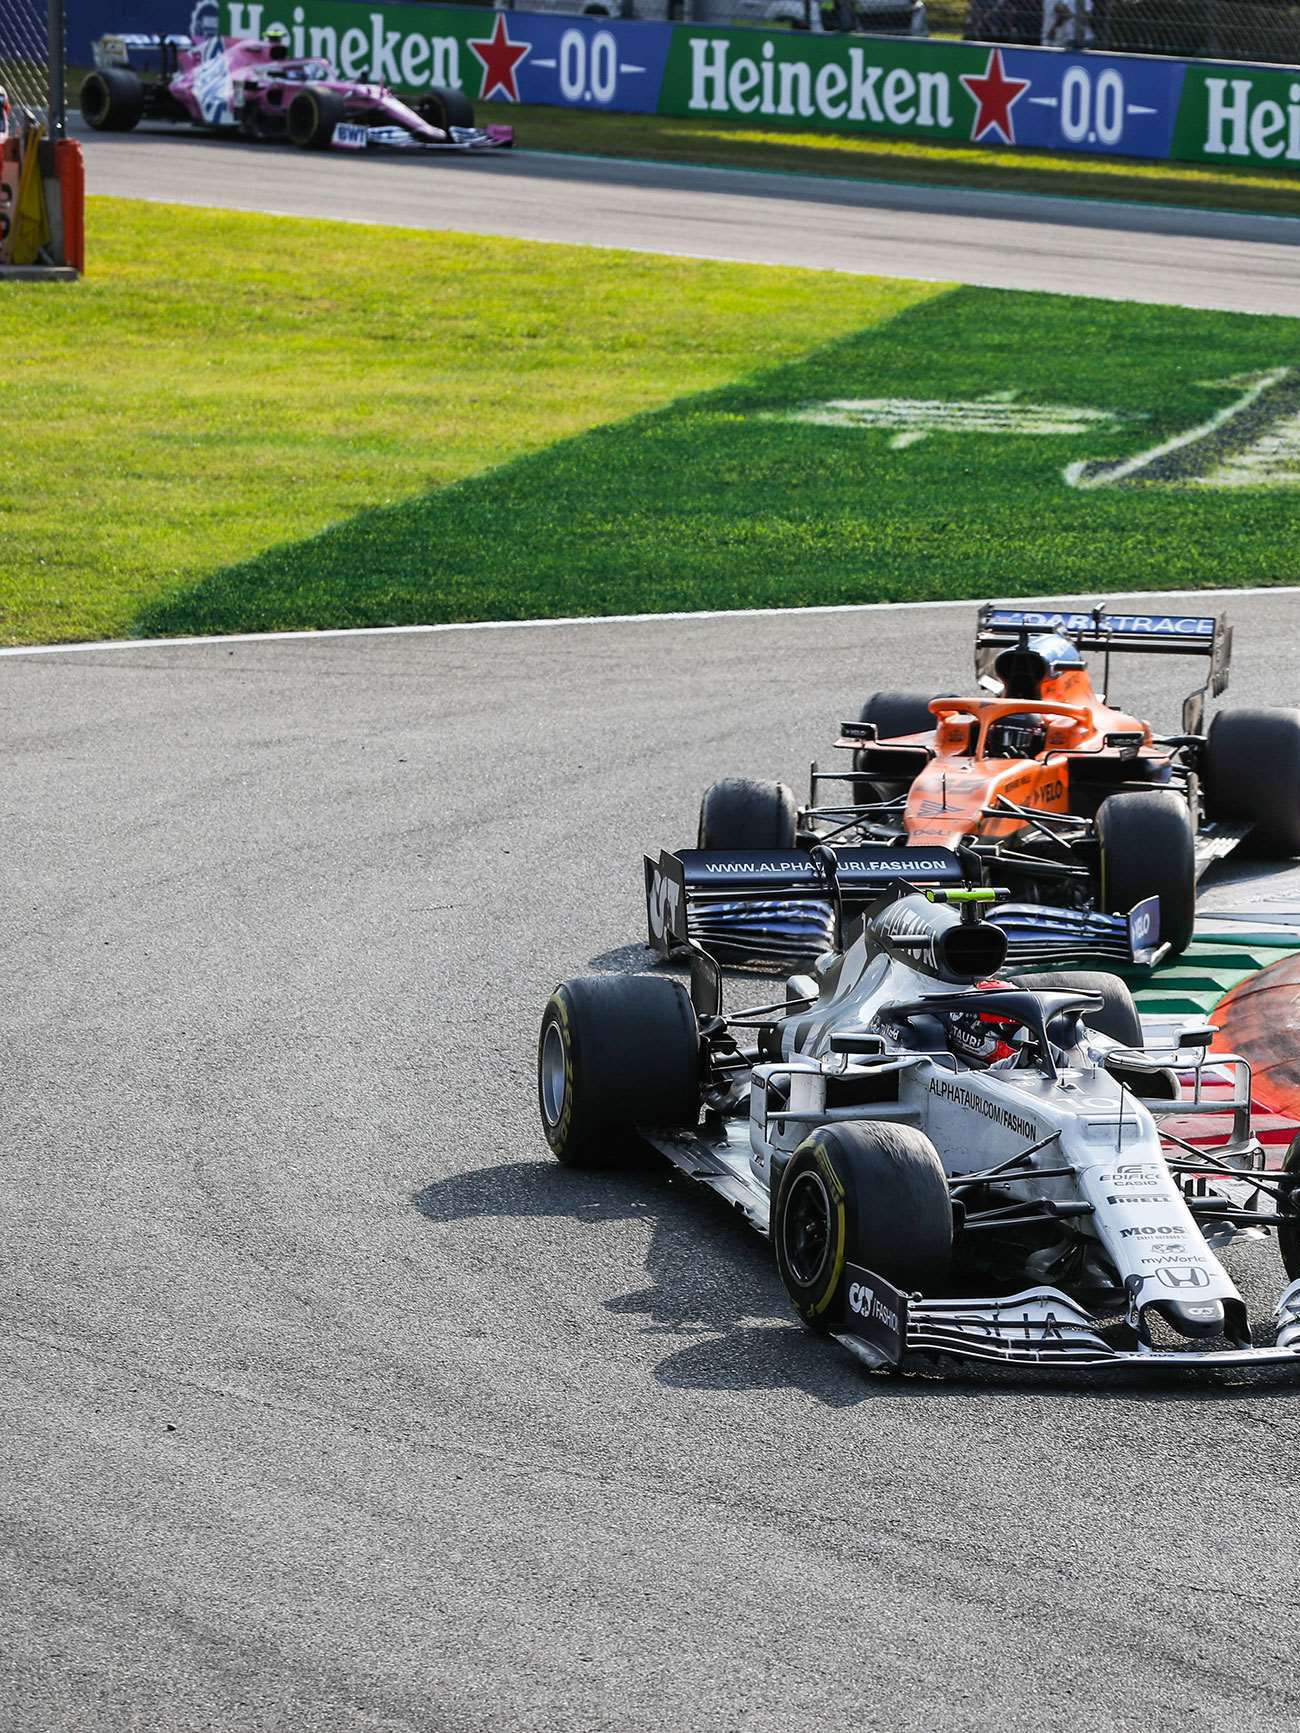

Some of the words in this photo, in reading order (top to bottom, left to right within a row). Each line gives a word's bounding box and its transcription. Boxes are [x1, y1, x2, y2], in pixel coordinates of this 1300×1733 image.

[560, 28, 617, 103] 0.0
[688, 37, 952, 128] Heineken
[1060, 65, 1125, 145] 0.0
[1025, 610, 1216, 636] DARKTRACE
[1039, 779, 1064, 804] VELO
[705, 860, 947, 874] WWW.ALPHAURI.FASHION
[929, 1077, 1037, 1142] ALPHATAURI.COM/FASHION
[1106, 1194, 1172, 1205] PIRELL
[1119, 1226, 1187, 1239] MOOS
